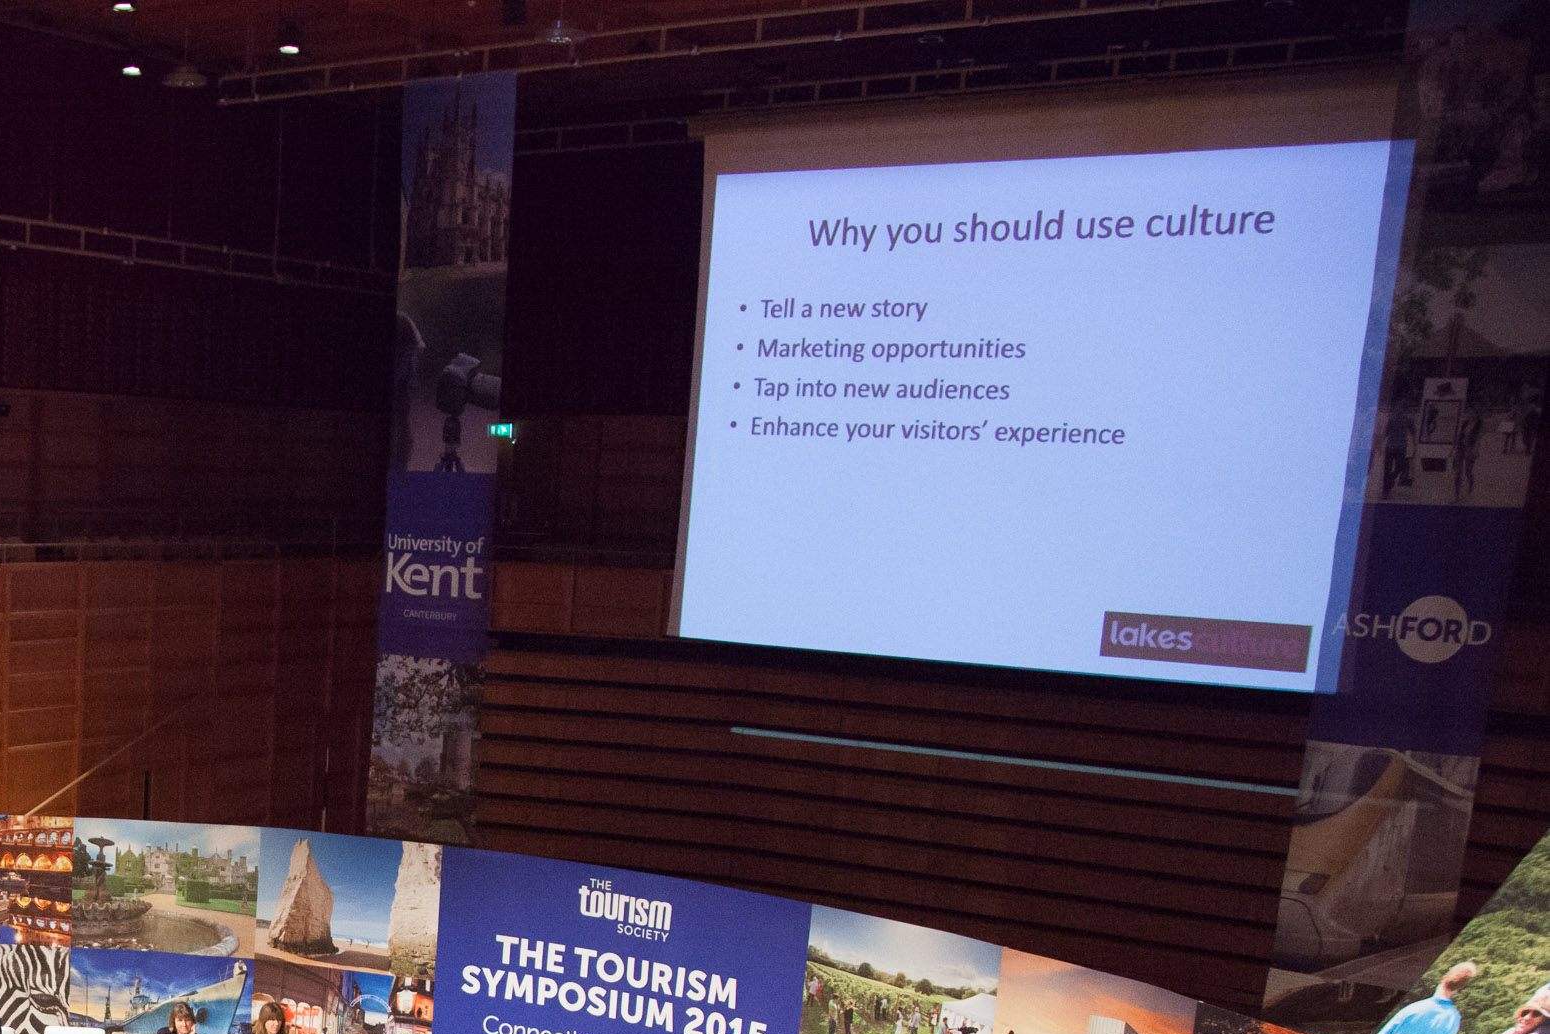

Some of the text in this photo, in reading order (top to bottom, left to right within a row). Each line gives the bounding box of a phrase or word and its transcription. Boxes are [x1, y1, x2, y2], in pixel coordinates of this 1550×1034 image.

[809, 204, 1276, 252] Why you should use culture
[761, 298, 928, 322] Tell a new story
[757, 338, 1026, 363] Marketing opportunities
[754, 377, 1010, 401] Tap into new audiences
[751, 416, 839, 438] Enhance
[845, 422, 896, 442] your
[994, 423, 1126, 447] experience
[387, 533, 485, 558] University of
[386, 551, 483, 599] Kent
[1332, 612, 1492, 647] ASHFORD
[589, 877, 612, 891] THE
[616, 923, 669, 942] SOCIETY
[495, 934, 738, 1010] THE TOURISM
[461, 964, 674, 1033] SYMPOSIUM
